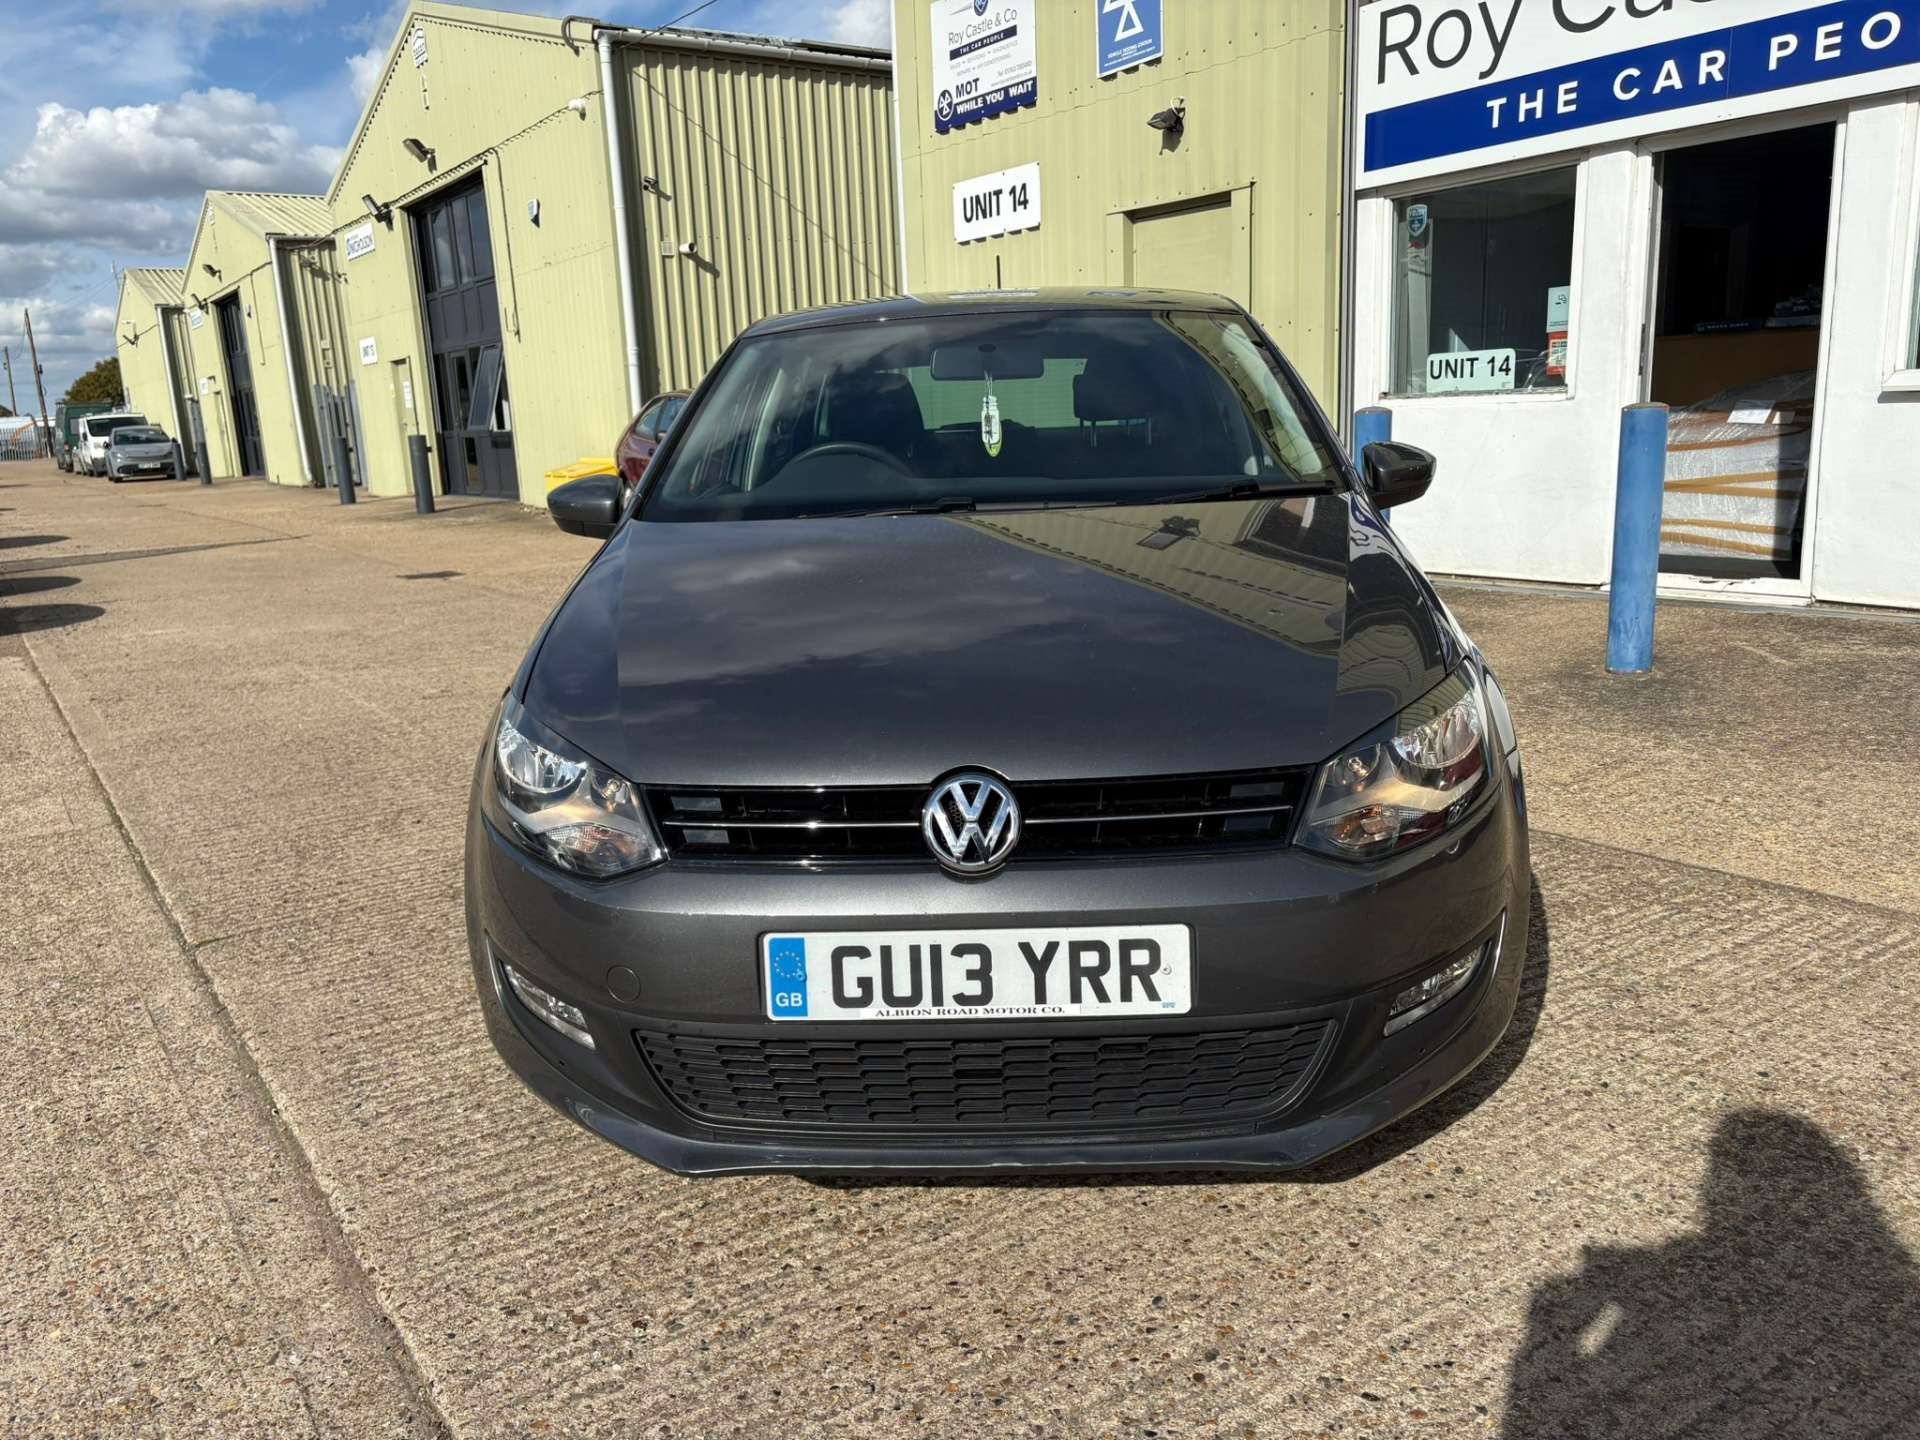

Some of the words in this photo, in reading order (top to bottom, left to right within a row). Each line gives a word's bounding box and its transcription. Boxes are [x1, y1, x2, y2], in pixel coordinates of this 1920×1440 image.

[948, 30, 964, 46] Roy
[965, 18, 993, 38] Castle
[994, 12, 1001, 27] &
[1003, 8, 1017, 23] Co
[959, 44, 970, 55] THE
[971, 40, 982, 50] CAR
[983, 32, 1004, 45] PEOPLE
[1377, 0, 1523, 84] Roy
[1486, 80, 1578, 128] THE
[1612, 50, 1725, 100] CAR
[1768, 11, 1901, 71] PEO
[956, 77, 980, 99] MOT
[956, 97, 984, 115] WHILE
[985, 90, 1004, 105] YOU
[1008, 80, 1033, 98] WAIT
[963, 188, 1003, 223] UNIT
[1009, 182, 1029, 213] 14
[1430, 357, 1479, 380] UNIT
[1487, 355, 1512, 378] 14
[928, 777, 1014, 868] VW
[831, 943, 994, 1009] GU13
[1017, 938, 1162, 1005] YRR
[775, 992, 803, 1008] GB
[875, 1008, 932, 1017] ALBION
[937, 1007, 978, 1016] ROAD
[983, 1006, 1037, 1015] MOTOR
[1042, 1005, 1065, 1014] CO.
